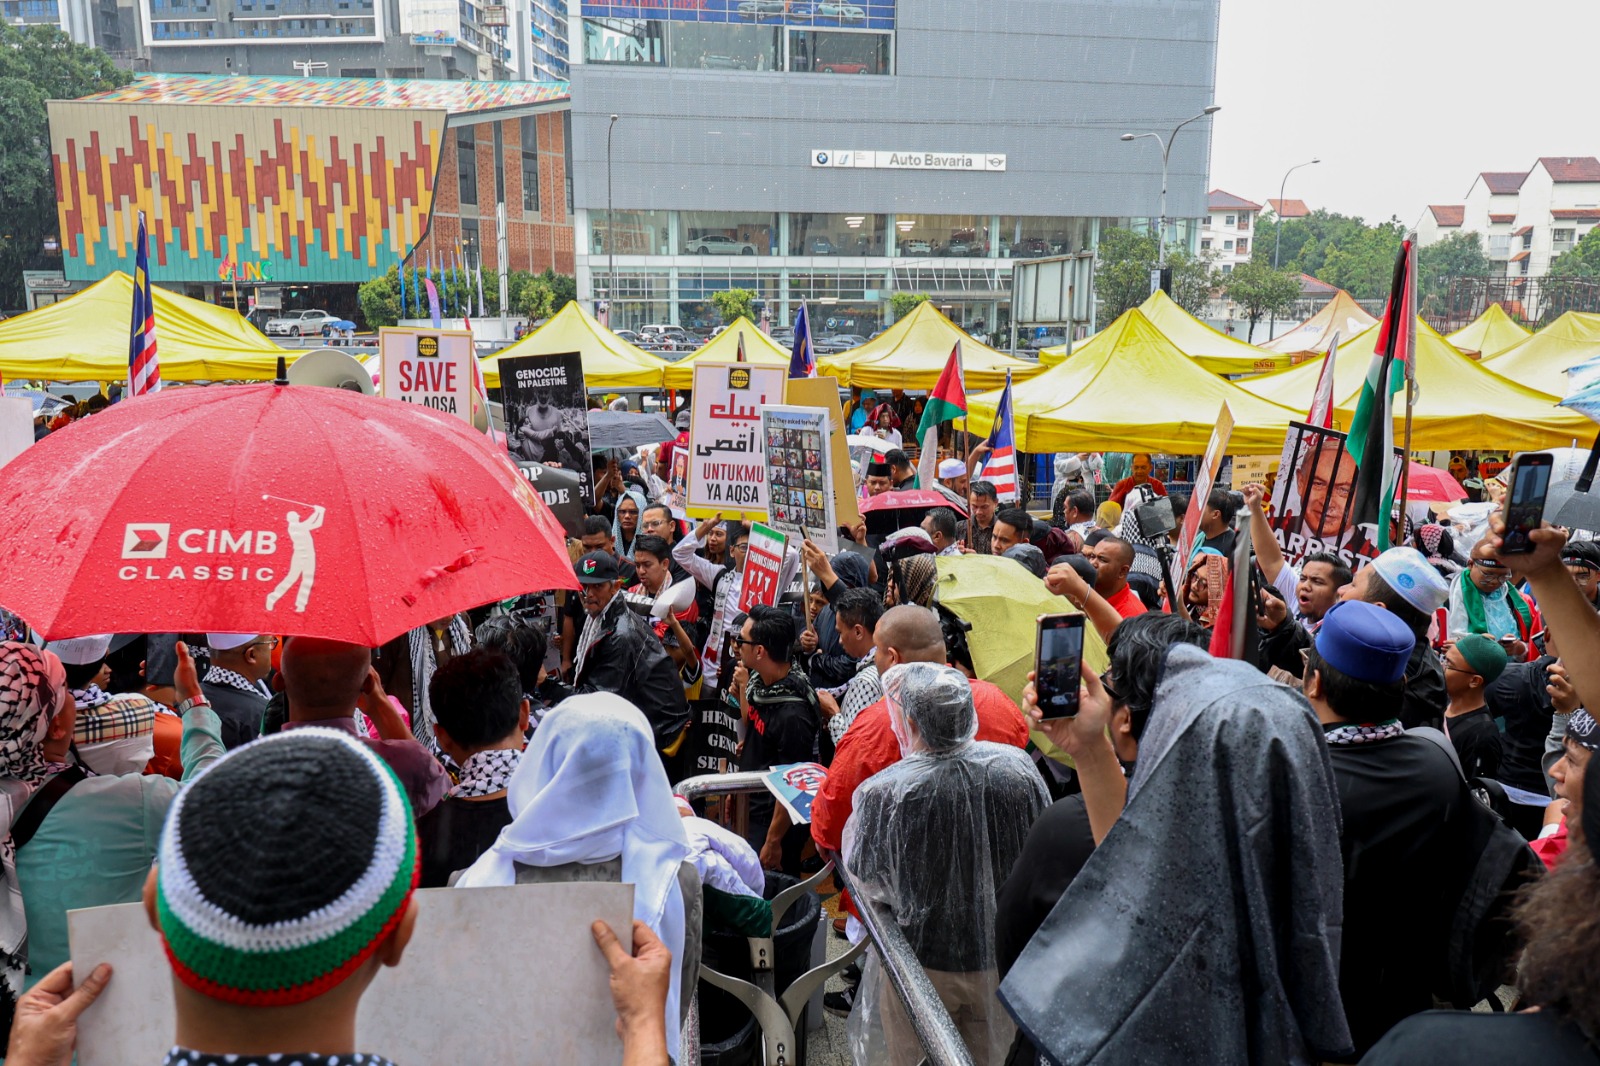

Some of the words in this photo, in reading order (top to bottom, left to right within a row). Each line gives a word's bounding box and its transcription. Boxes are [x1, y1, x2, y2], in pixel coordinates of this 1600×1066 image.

[589, 34, 660, 62] MINI
[889, 153, 921, 167] Auto
[924, 154, 973, 168] Bavaria
[399, 360, 457, 392] SAVE
[515, 366, 566, 380] GENOCIDE
[517, 380, 527, 389] IN
[527, 376, 568, 388] PALESTINE
[703, 462, 764, 483] UNTUKMU
[706, 482, 721, 500] YA
[725, 484, 759, 504] AQSA
[178, 528, 278, 555] CIMB
[118, 565, 274, 582] CLASSIC
